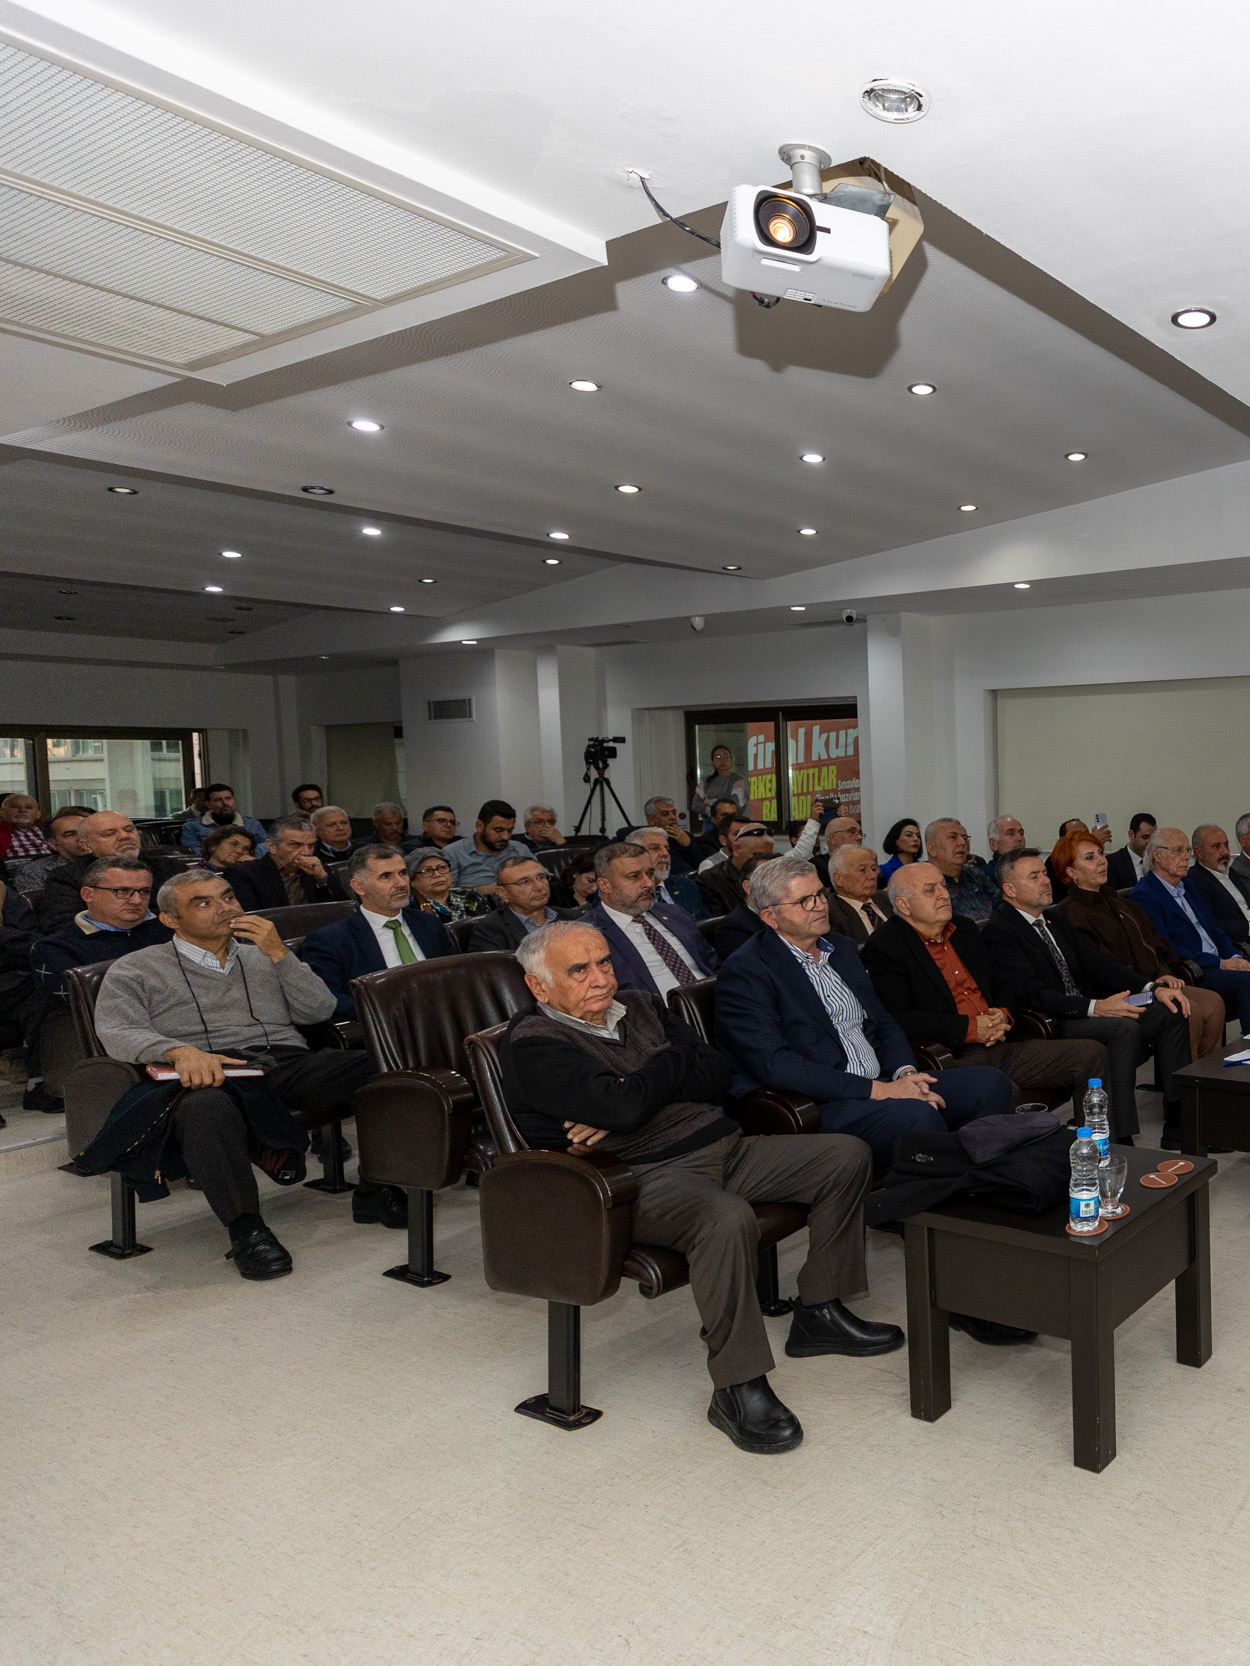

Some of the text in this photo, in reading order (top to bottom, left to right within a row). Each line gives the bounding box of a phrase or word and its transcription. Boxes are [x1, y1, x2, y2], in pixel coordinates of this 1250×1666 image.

[748, 765, 837, 800] RKEN AYITLAR
[762, 795, 811, 821] BAADI
